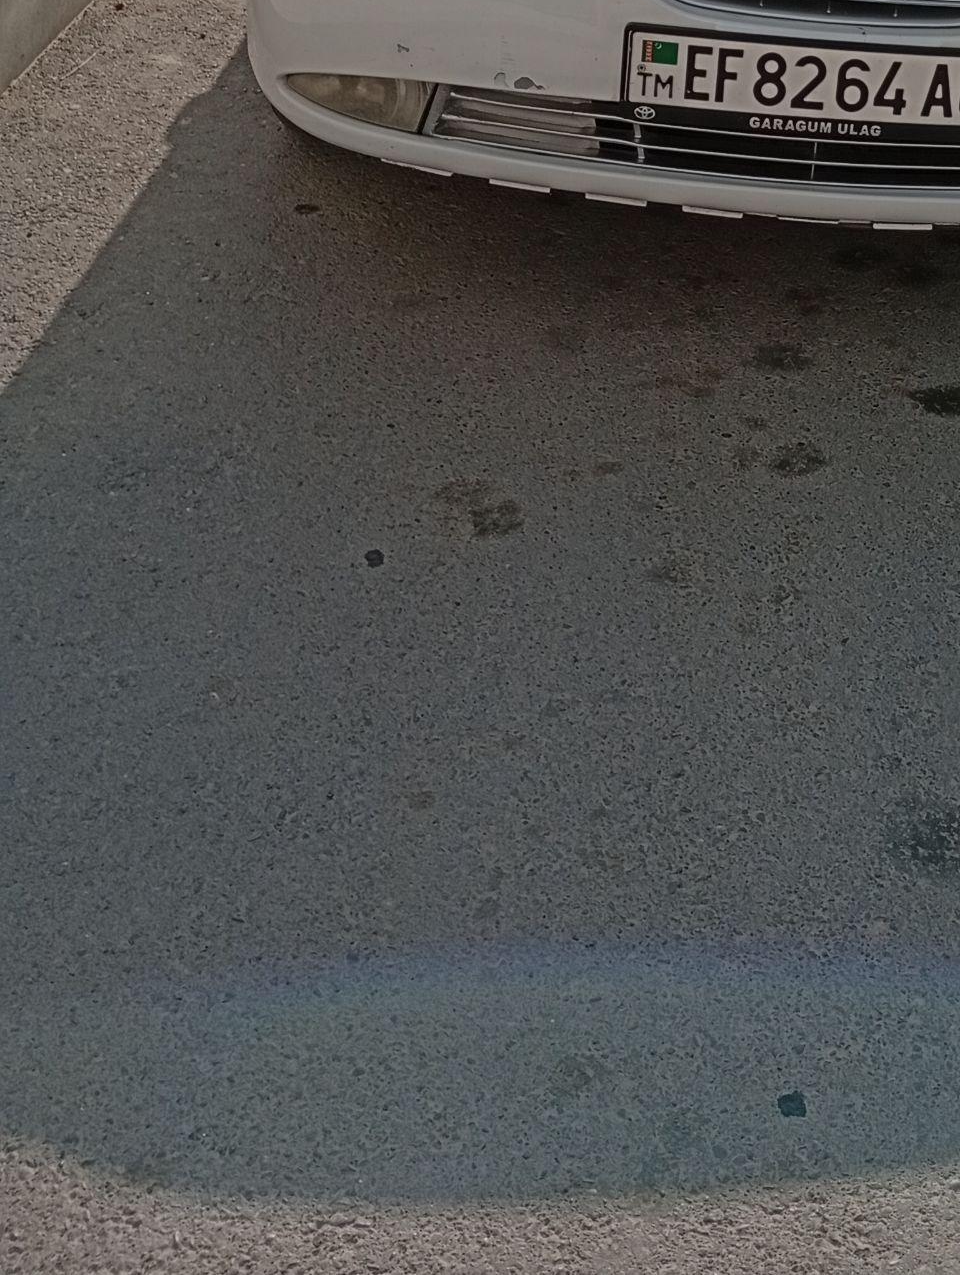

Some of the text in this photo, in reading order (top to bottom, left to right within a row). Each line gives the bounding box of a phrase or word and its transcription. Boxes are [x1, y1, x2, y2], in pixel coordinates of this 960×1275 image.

[637, 72, 673, 98] TM
[750, 116, 881, 136] GARAGUM ULAG
